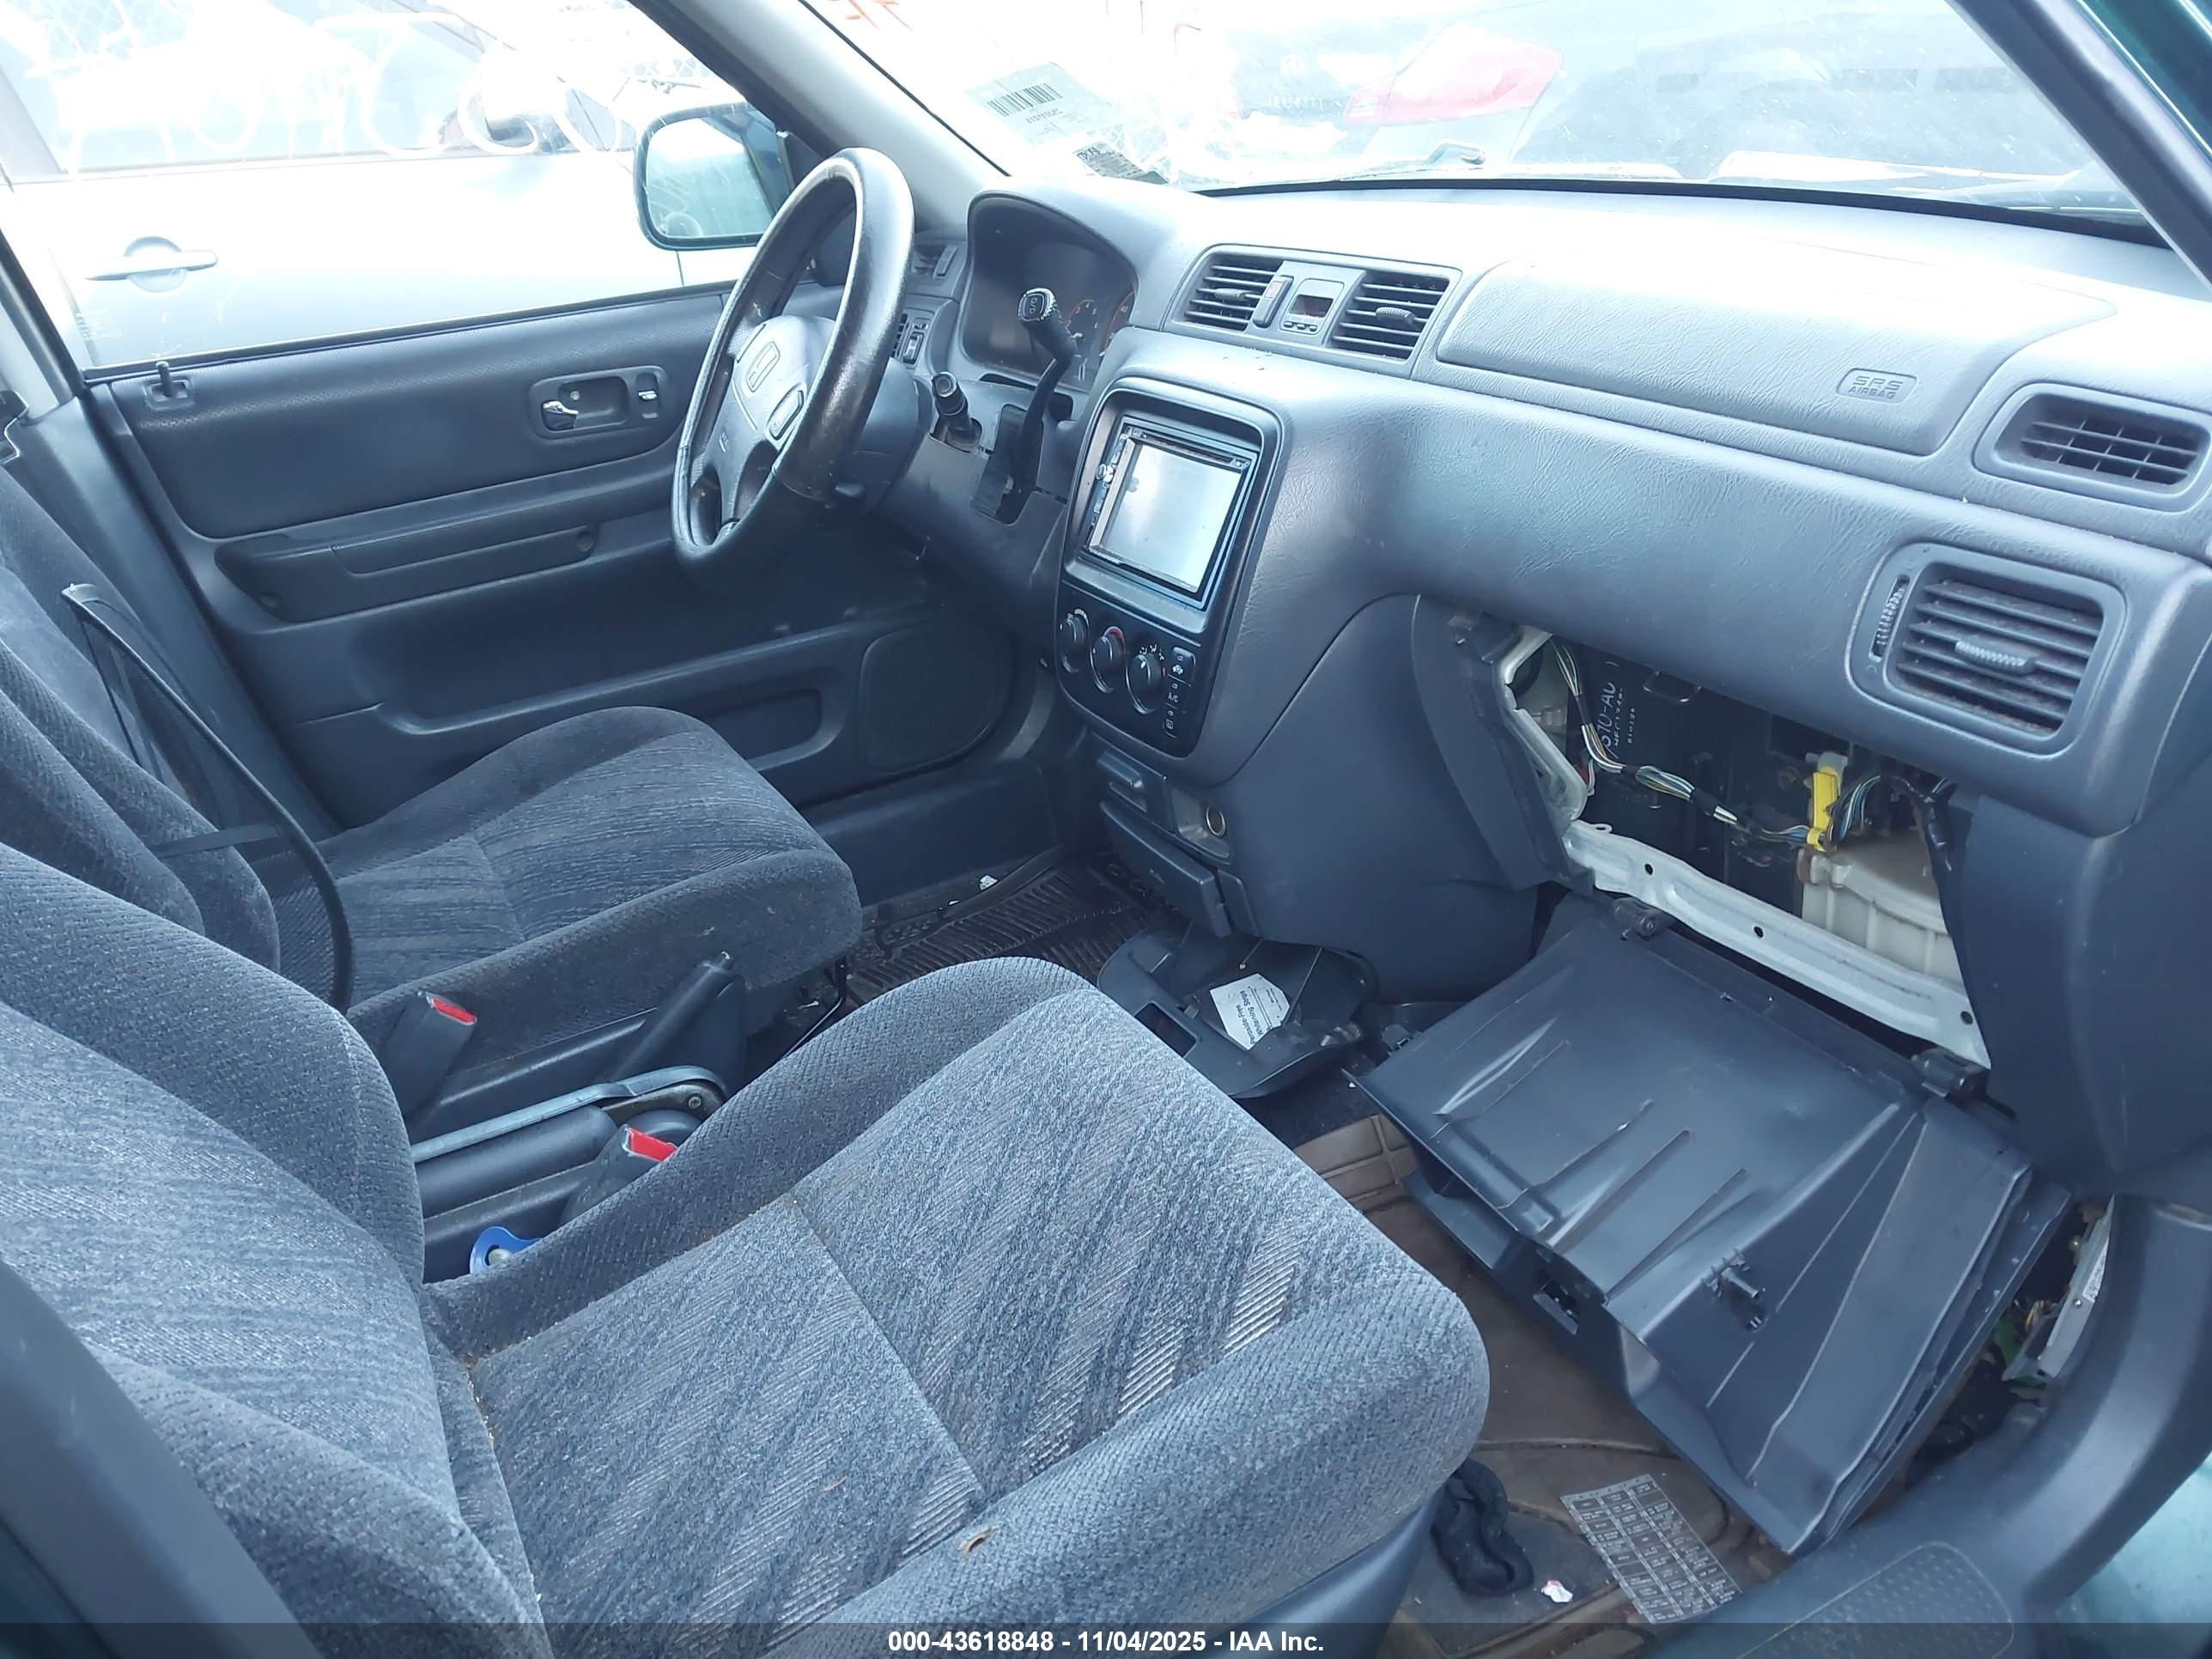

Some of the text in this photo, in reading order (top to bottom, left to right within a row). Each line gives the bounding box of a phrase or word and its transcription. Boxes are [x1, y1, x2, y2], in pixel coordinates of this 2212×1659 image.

[1853, 375, 1904, 391] SRS
[1848, 386, 1897, 399] AIRBAG
[1168, 691, 1178, 703] A/C
[1237, 1004, 1255, 1044] Peroxide-Free
[1248, 1006, 1264, 1036] Whitening
